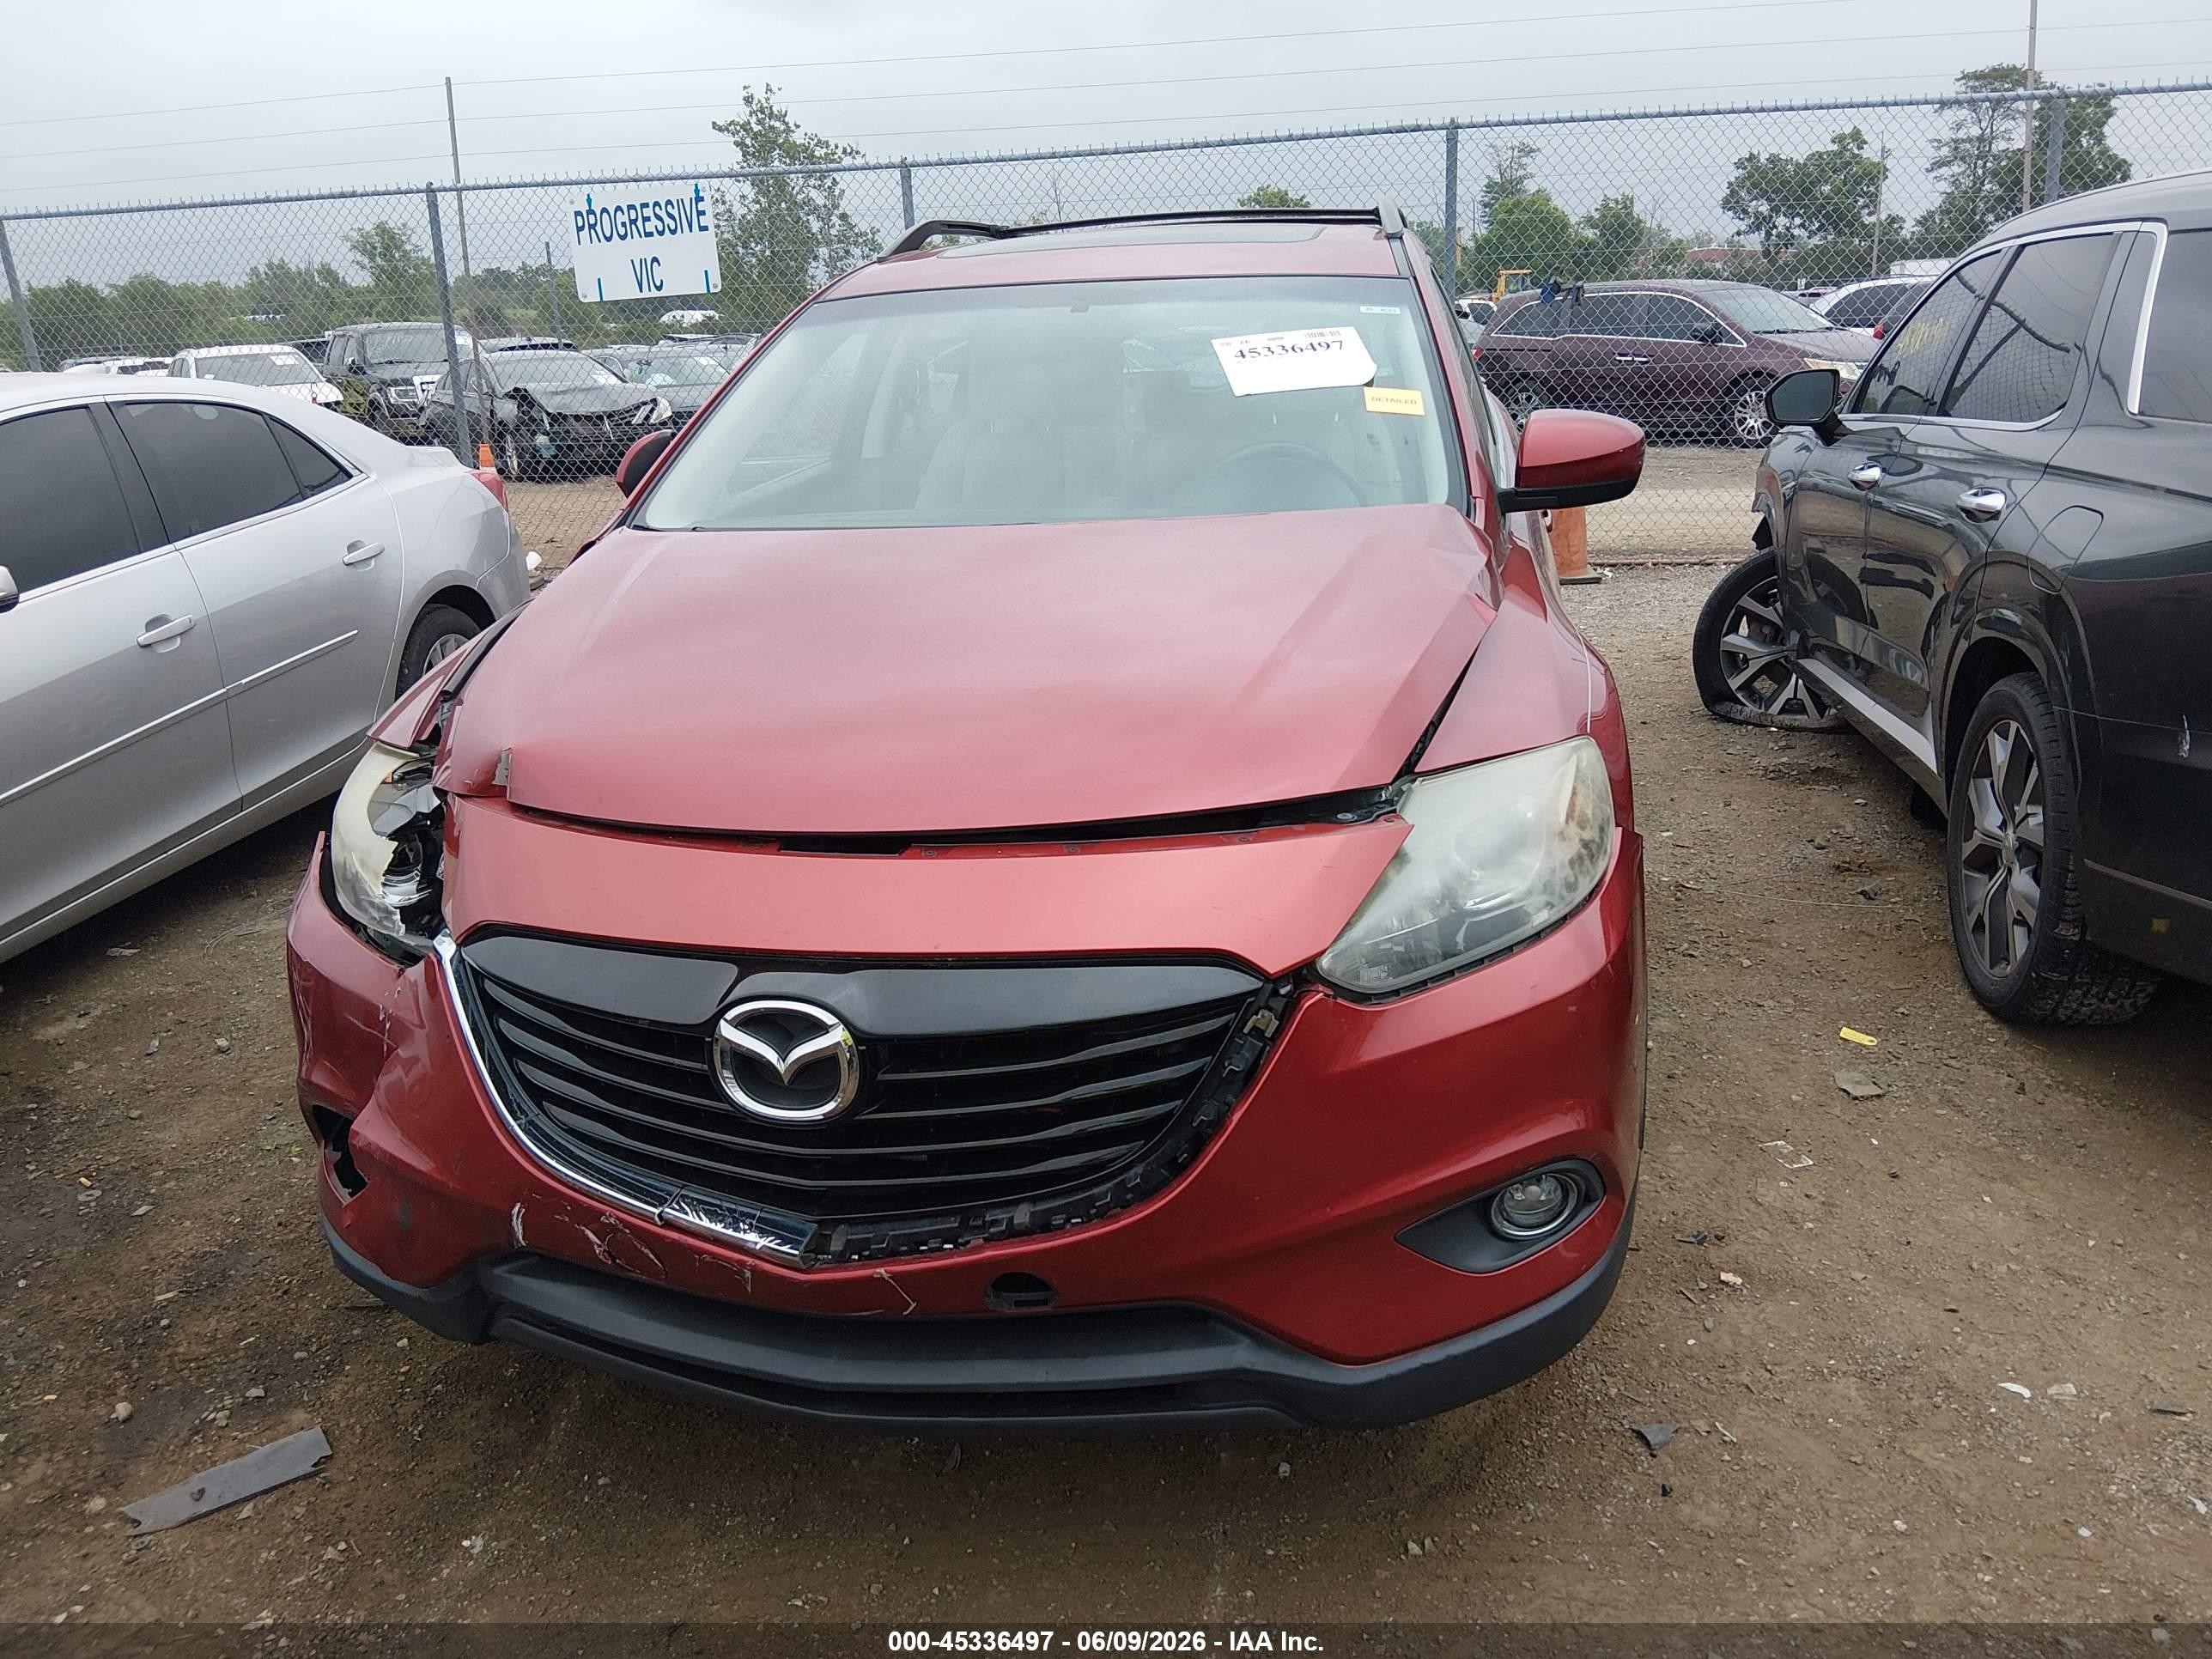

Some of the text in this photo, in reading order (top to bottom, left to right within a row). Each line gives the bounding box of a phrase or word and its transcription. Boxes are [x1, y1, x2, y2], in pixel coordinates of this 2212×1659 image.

[574, 196, 709, 246] PROGRESSIVE
[630, 256, 664, 294] VIC
[1233, 340, 1343, 359] 45336497
